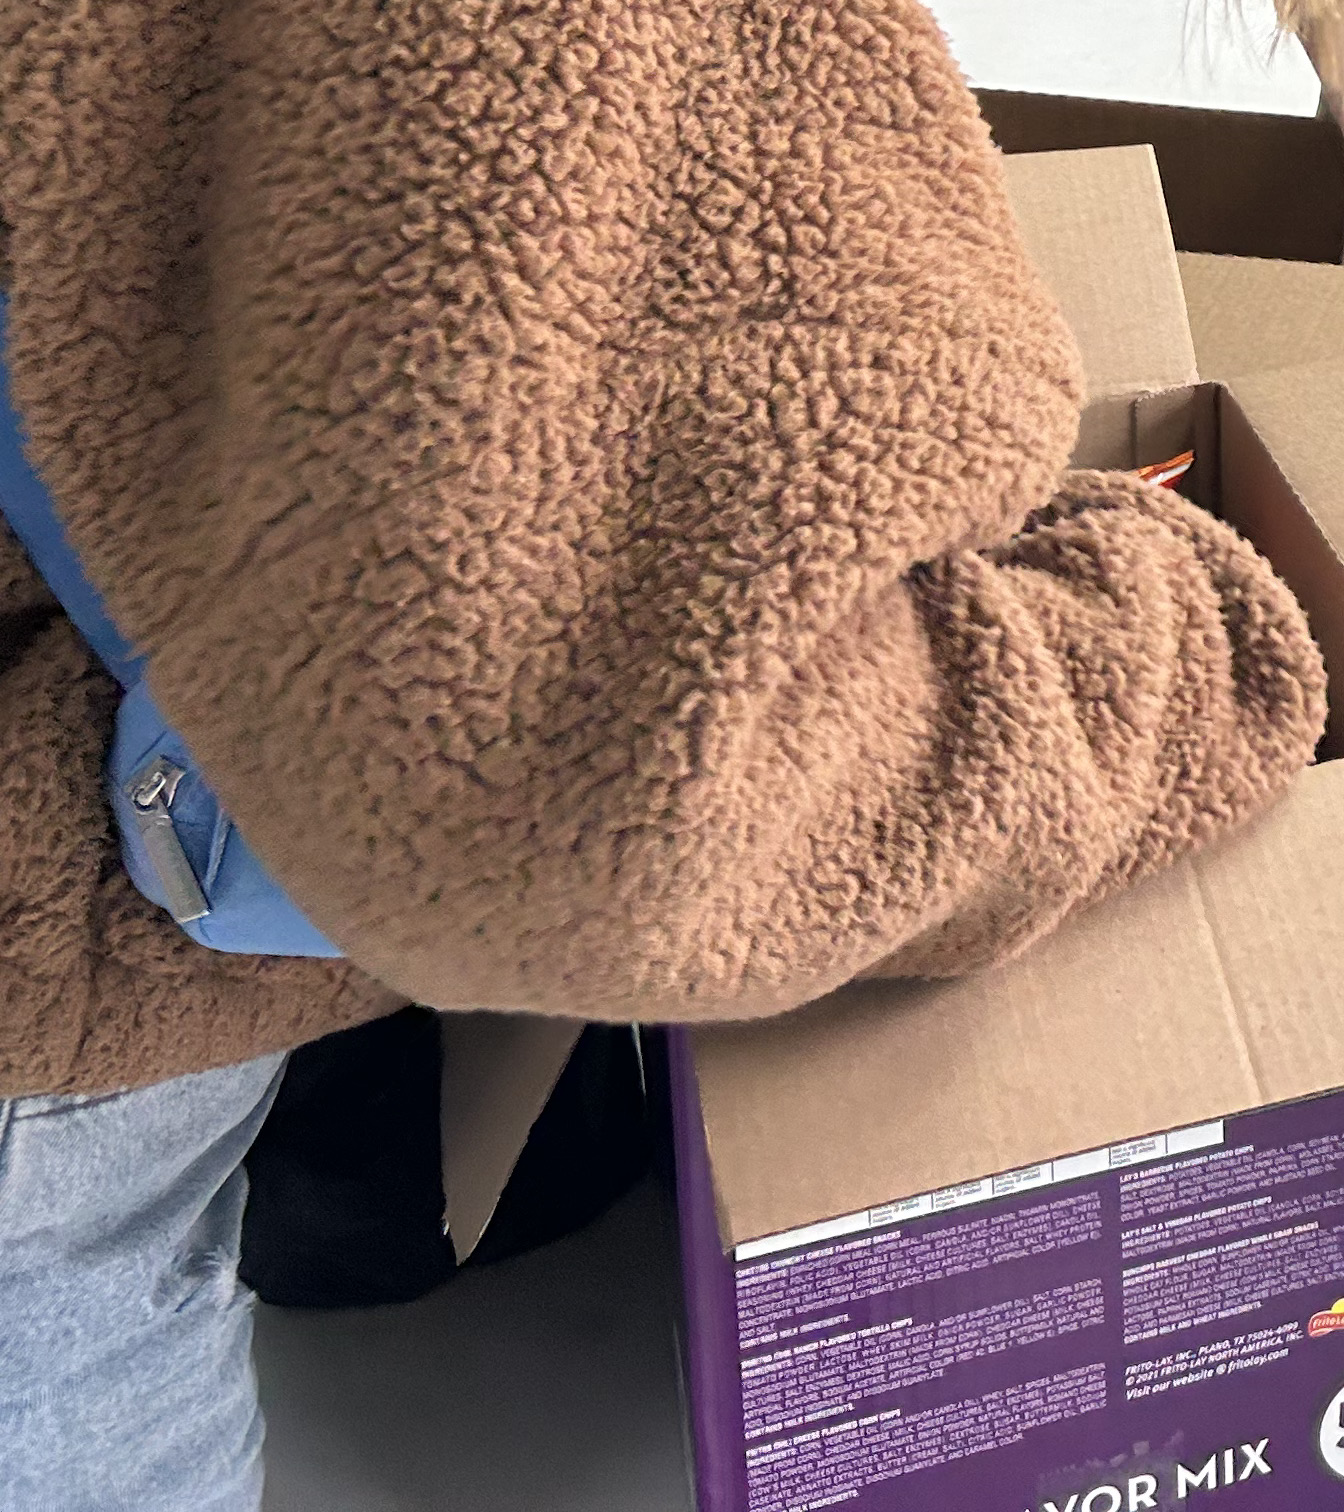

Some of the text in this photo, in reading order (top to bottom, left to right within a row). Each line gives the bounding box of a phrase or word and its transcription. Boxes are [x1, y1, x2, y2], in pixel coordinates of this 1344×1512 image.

[1126, 1385, 1151, 1401] Visit
[1152, 1380, 1171, 1394] our
[1172, 1367, 1214, 1387] website
[1227, 1347, 1289, 1374] fritolay.com
[1176, 1437, 1273, 1501] MIX
